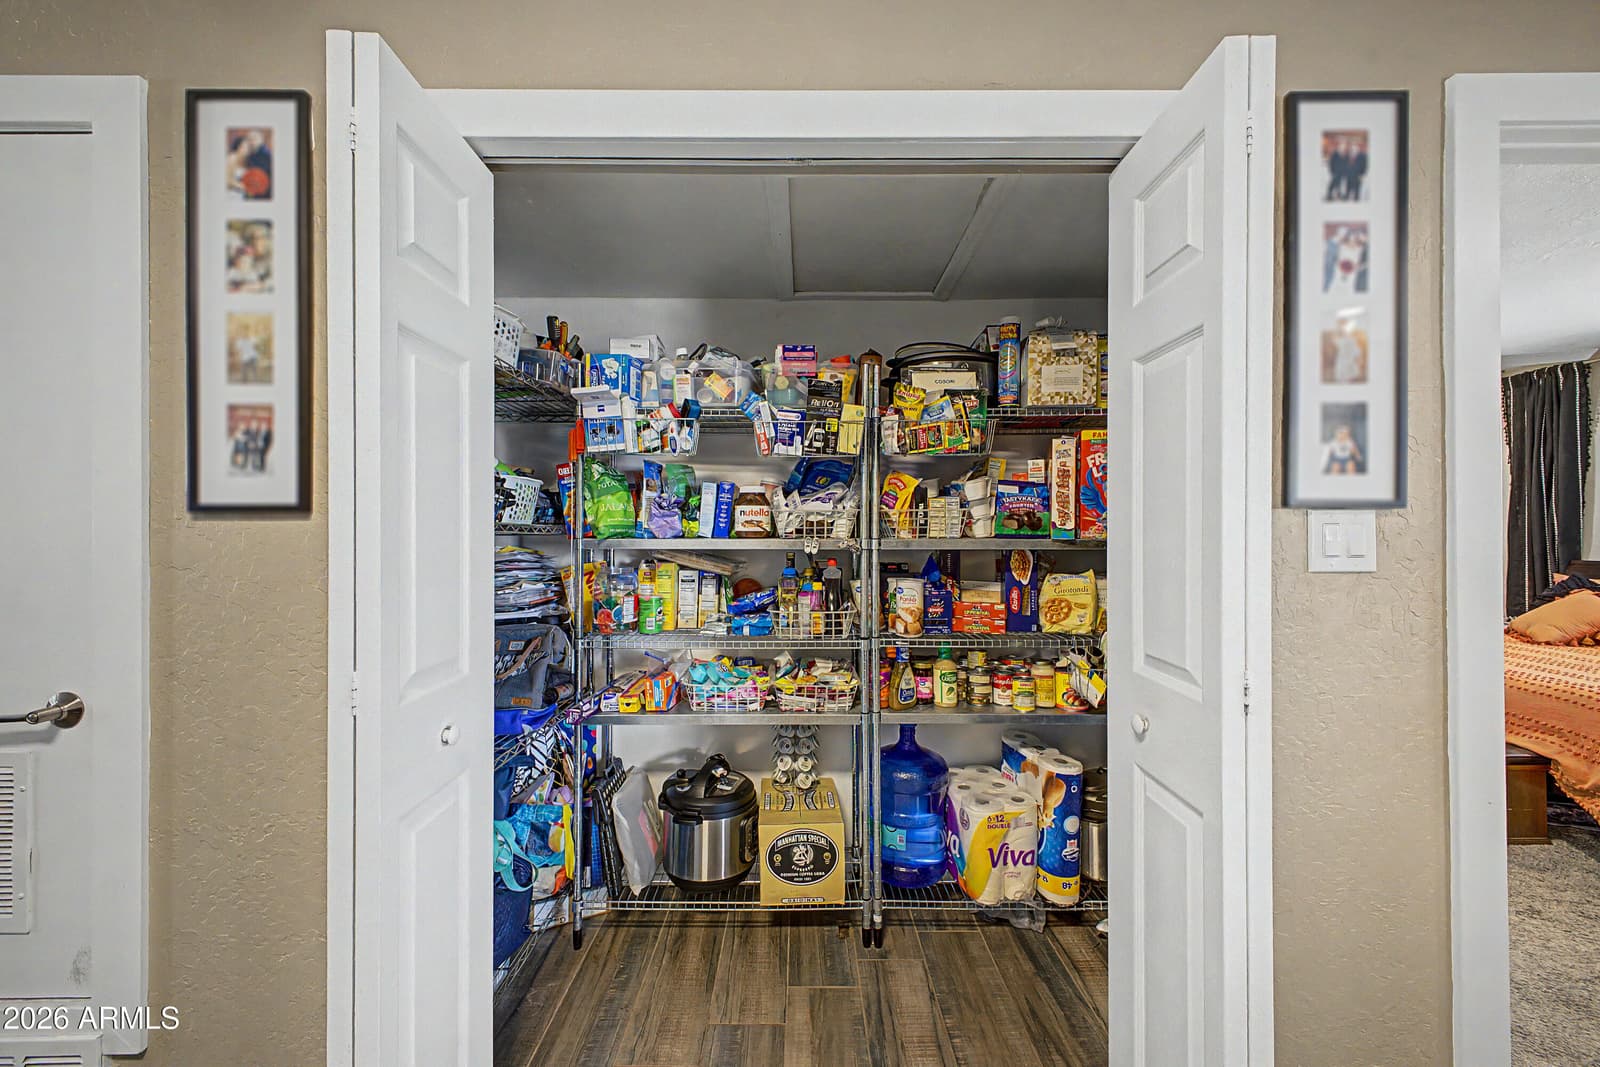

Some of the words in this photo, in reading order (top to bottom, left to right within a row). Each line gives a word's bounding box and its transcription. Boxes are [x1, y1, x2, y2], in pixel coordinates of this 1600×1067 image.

[740, 508, 770, 517] nutella
[777, 834, 808, 847] MANHATTAN
[808, 834, 827, 845] SPECIAL
[988, 842, 1035, 868] Viva
